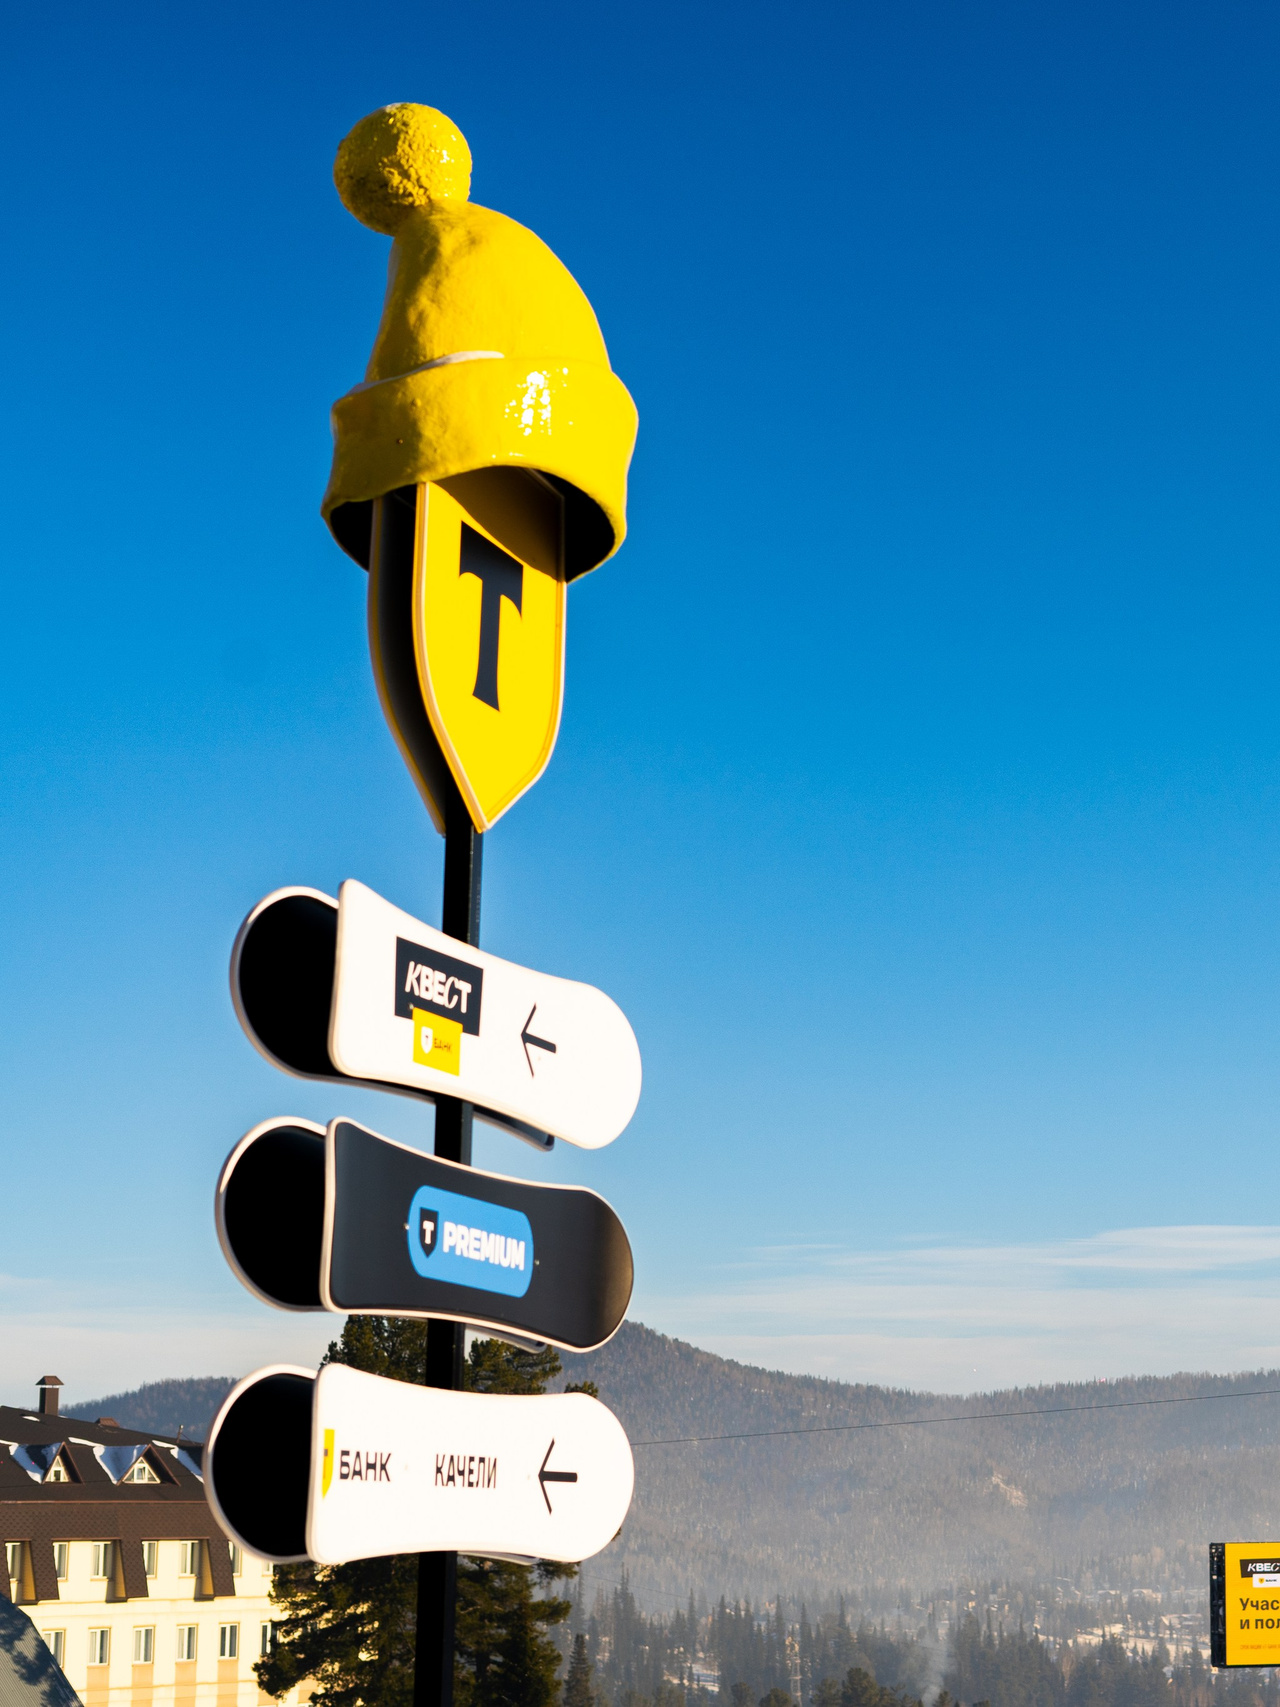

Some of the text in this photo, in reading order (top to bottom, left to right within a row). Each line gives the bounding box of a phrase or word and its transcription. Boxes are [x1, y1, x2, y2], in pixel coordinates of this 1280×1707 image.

[404, 960, 472, 1014] КВЕСТ
[433, 1037, 453, 1054] БАНК
[443, 1221, 526, 1271] PREMIUM
[339, 1449, 392, 1482] БАНК
[434, 1453, 498, 1489] КАЧЕЛИ
[1239, 1618, 1250, 1630] и
